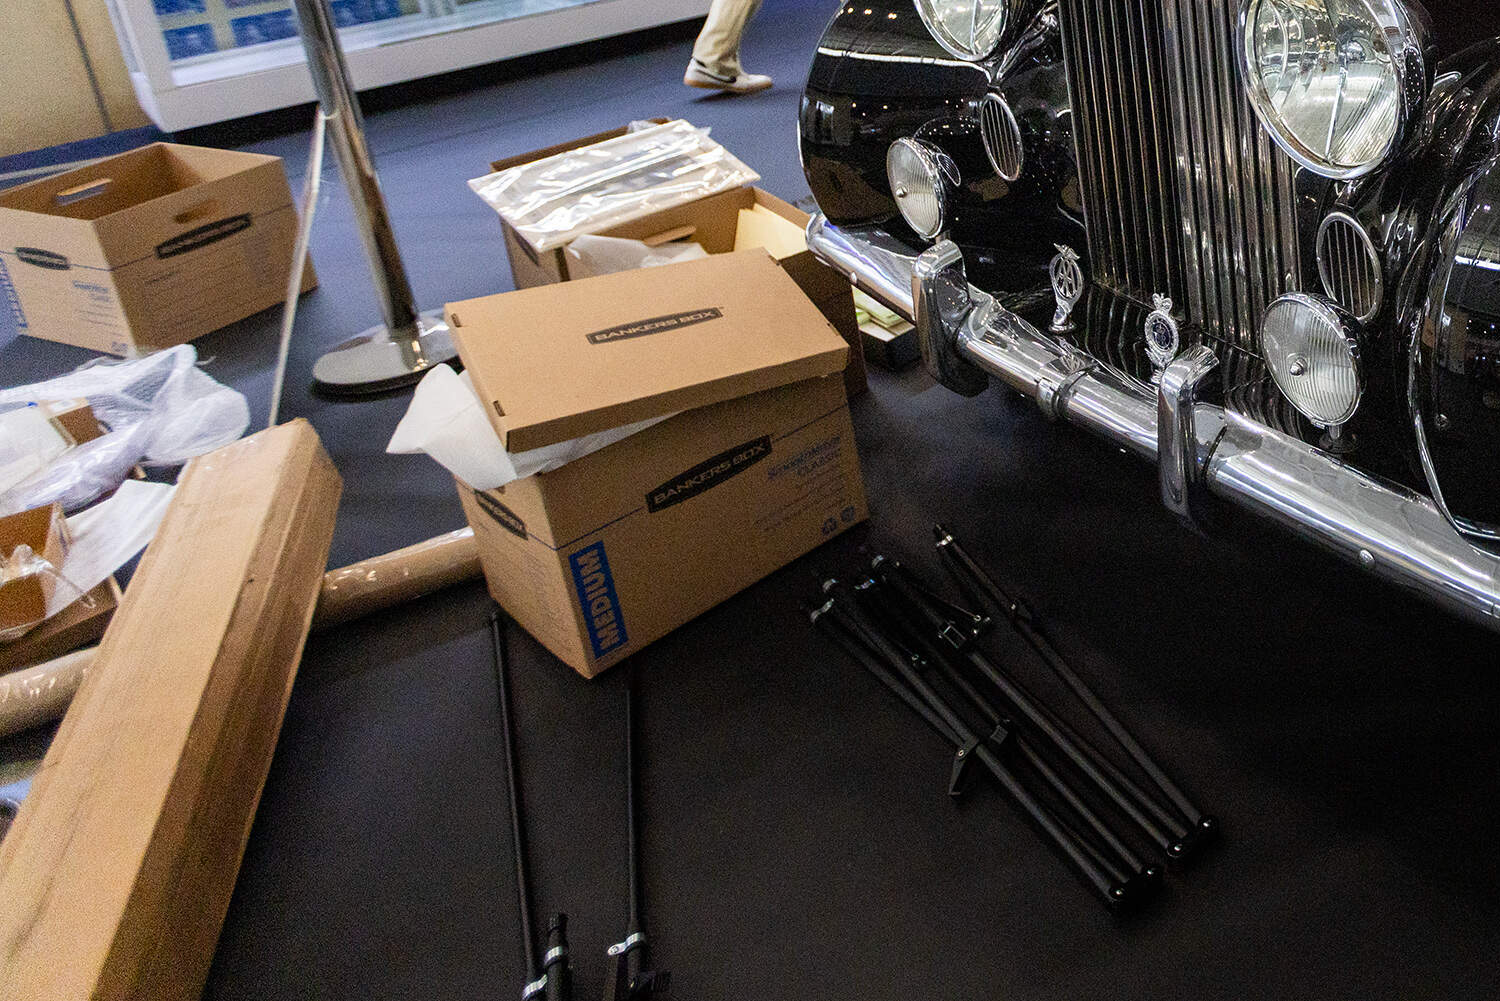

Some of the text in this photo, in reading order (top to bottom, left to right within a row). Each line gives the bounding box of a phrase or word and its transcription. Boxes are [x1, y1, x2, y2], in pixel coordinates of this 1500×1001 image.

[594, 309, 718, 342] BANKERS BOX
[653, 459, 731, 505] BANKERS
[732, 443, 767, 470] BOX
[575, 549, 620, 652] MEDIUM
